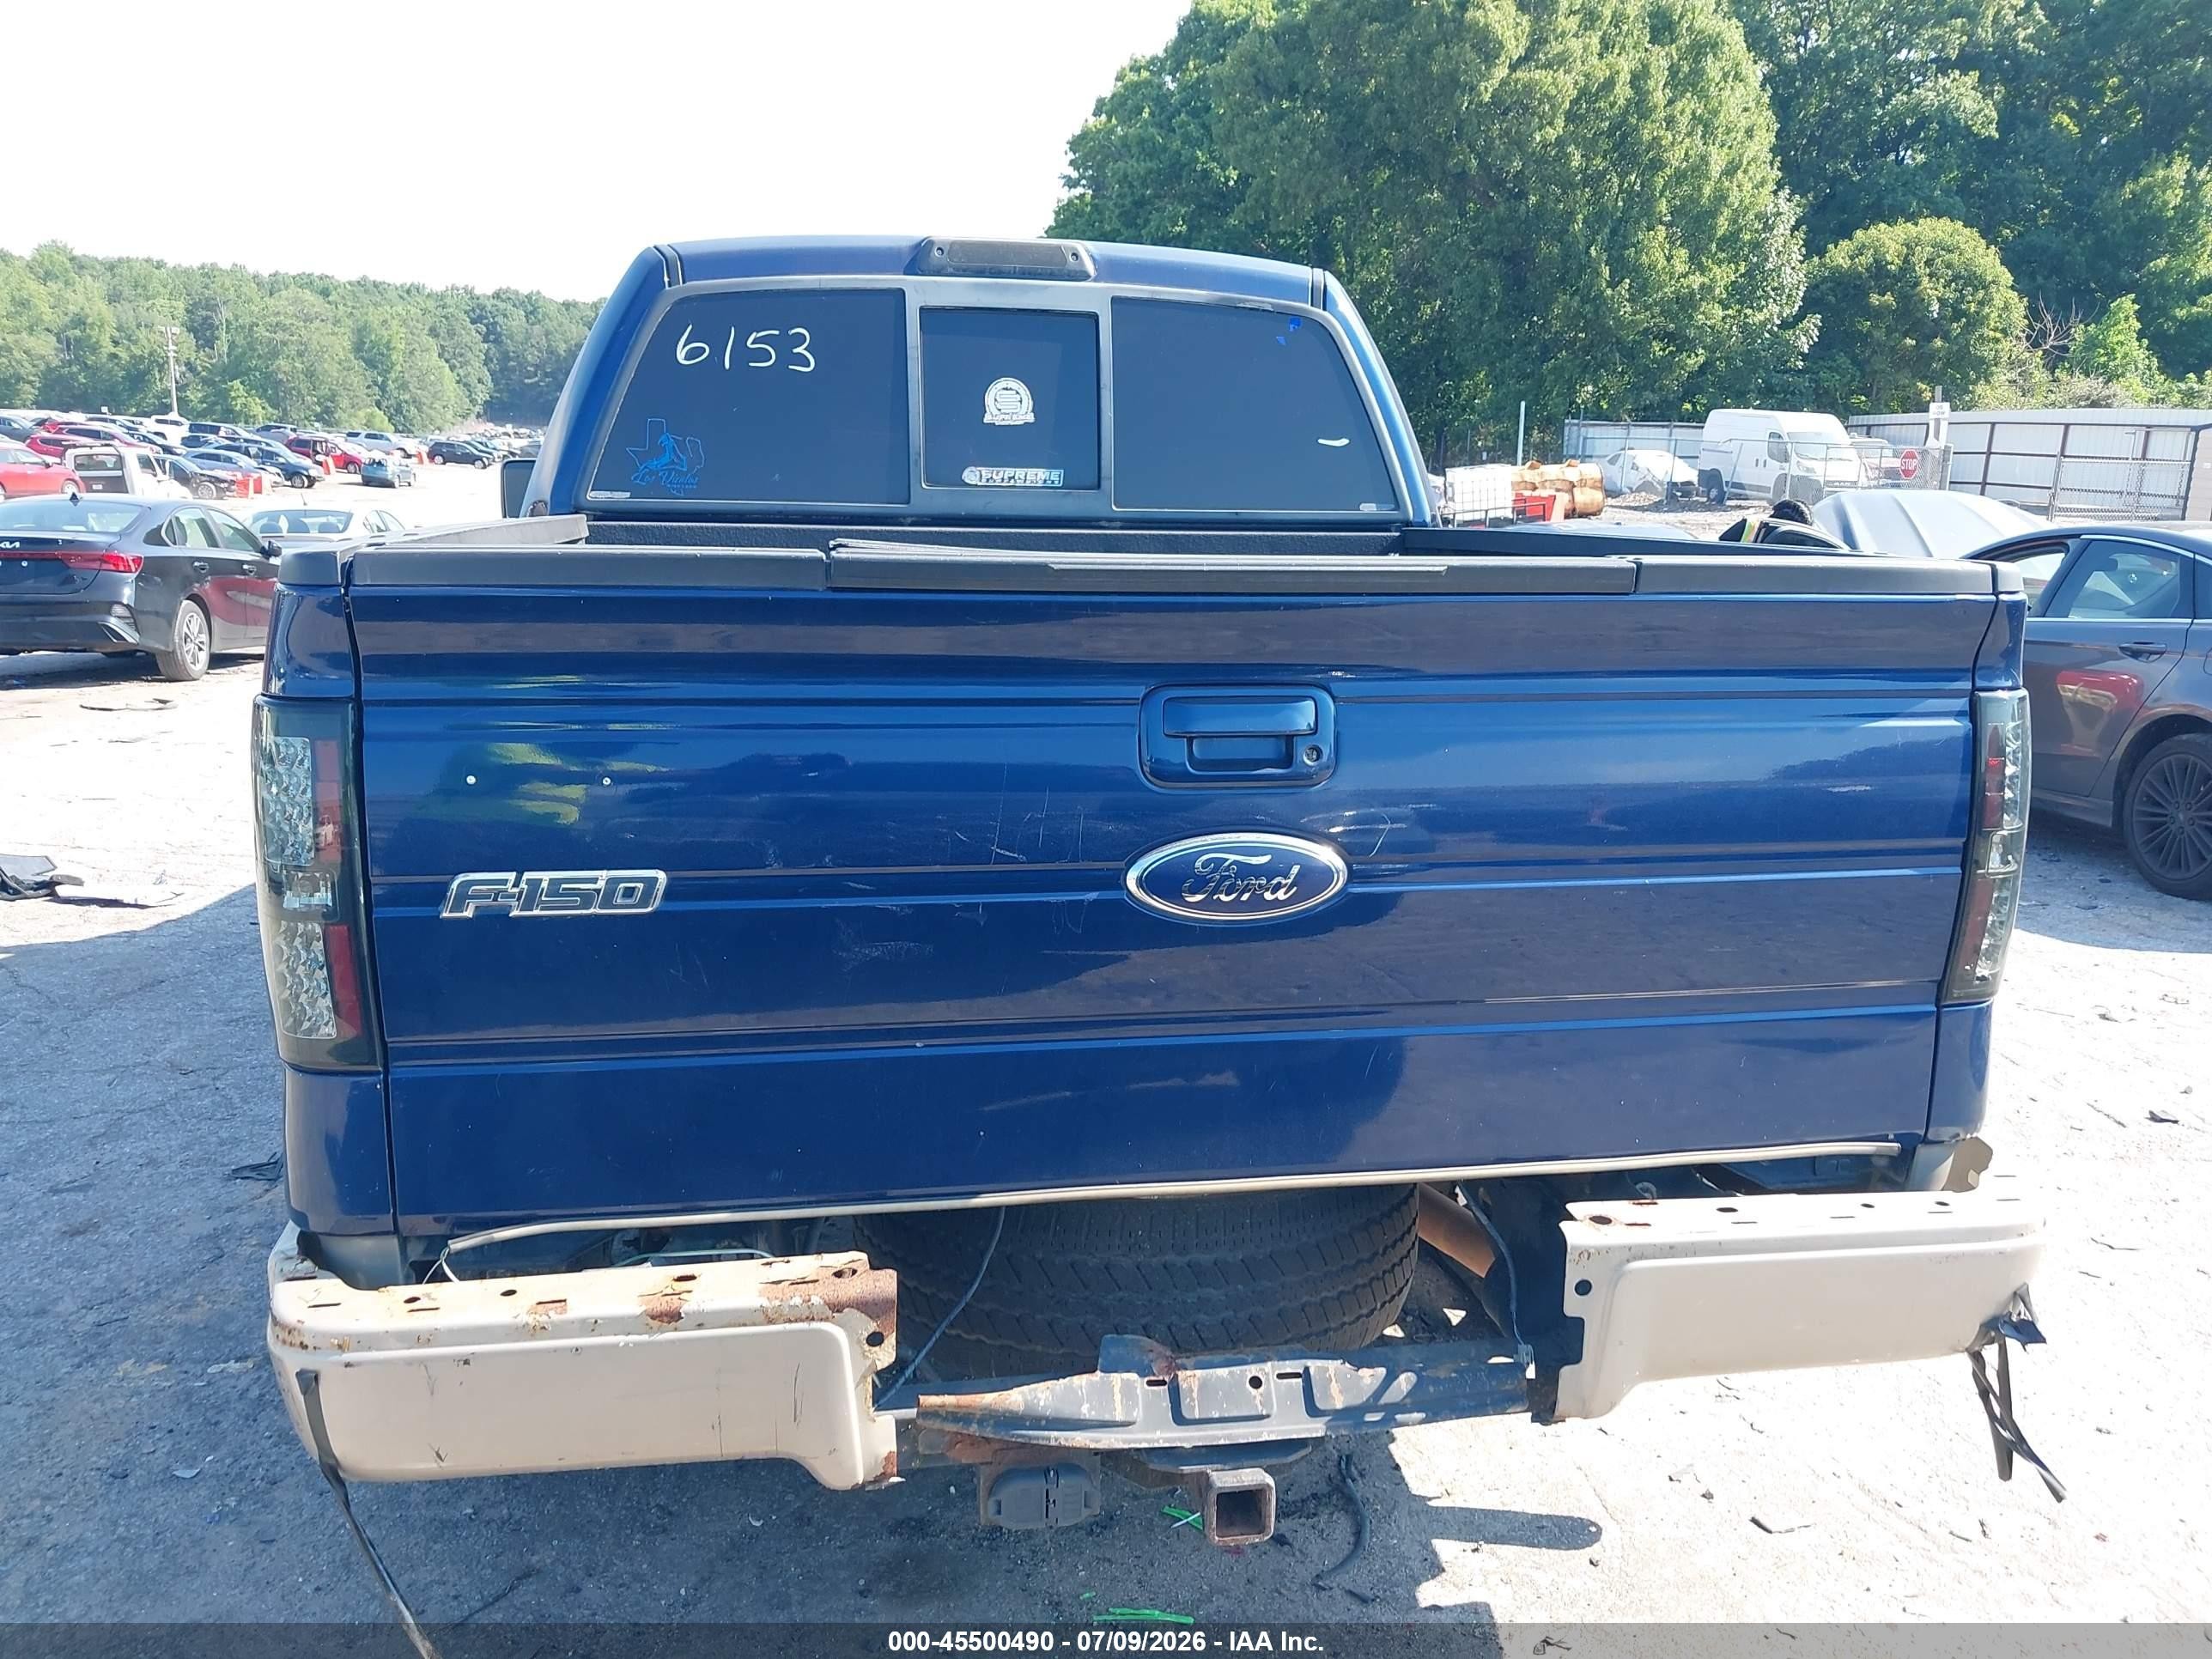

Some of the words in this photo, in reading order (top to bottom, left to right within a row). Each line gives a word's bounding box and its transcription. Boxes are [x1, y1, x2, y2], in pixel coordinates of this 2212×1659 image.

[675, 324, 816, 373] 6153
[981, 469, 1061, 481] SUPREME
[1901, 458, 1917, 471] STOP
[439, 869, 667, 919] F-150
[1181, 853, 1301, 902] Ford
